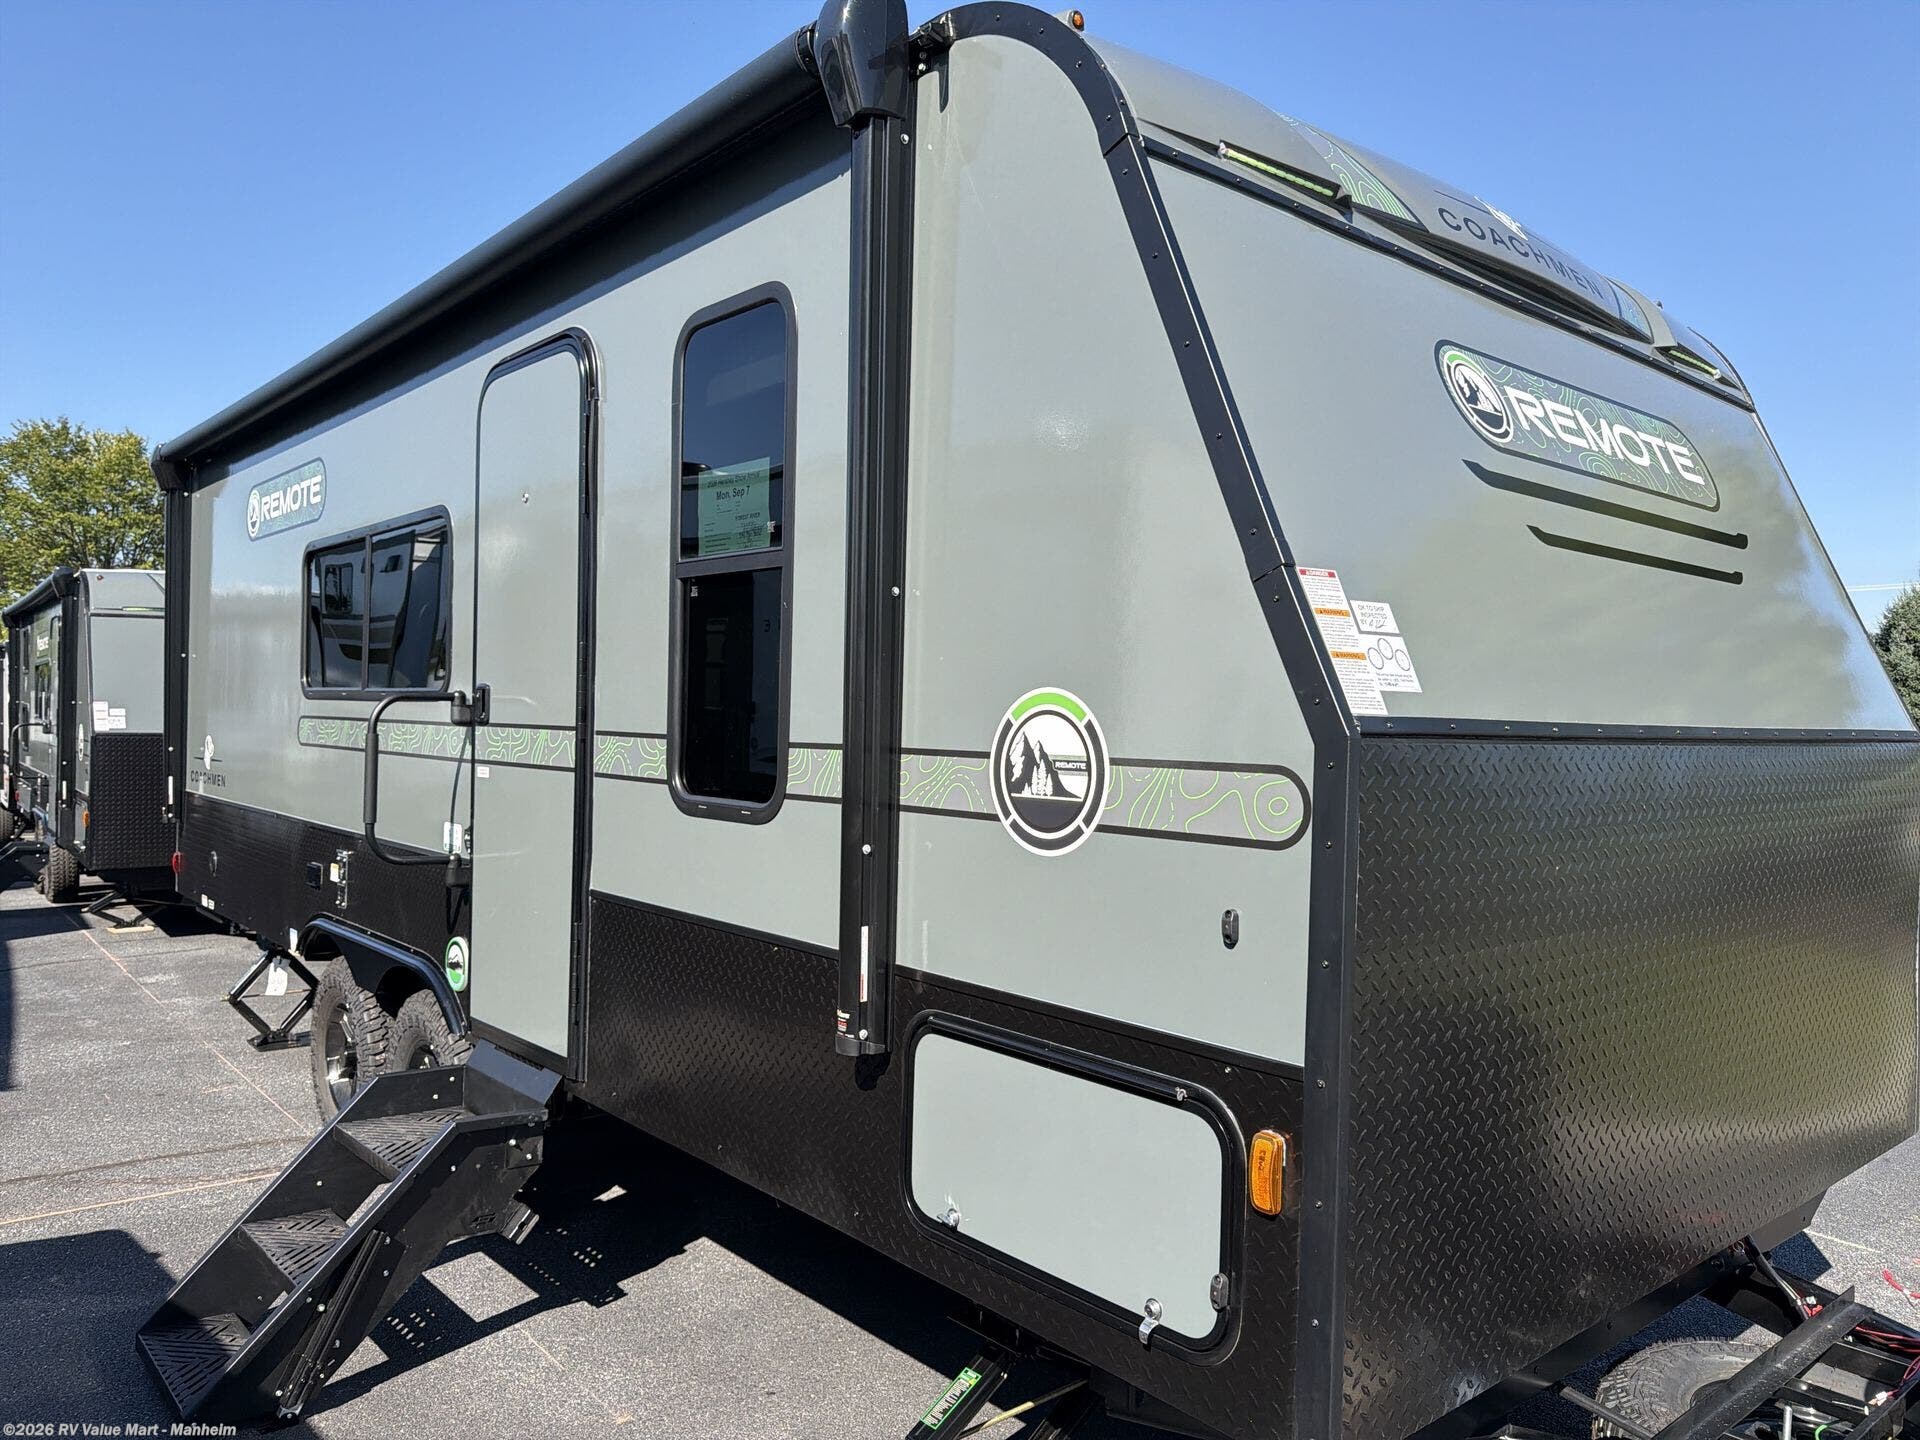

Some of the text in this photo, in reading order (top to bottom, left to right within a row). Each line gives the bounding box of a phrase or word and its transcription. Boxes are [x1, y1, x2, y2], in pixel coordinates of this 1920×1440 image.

[1438, 208, 1604, 300] COACHMEN
[1503, 385, 1706, 486] REMOTE
[261, 475, 322, 522] REMOTE
[732, 487, 745, 500] Sep
